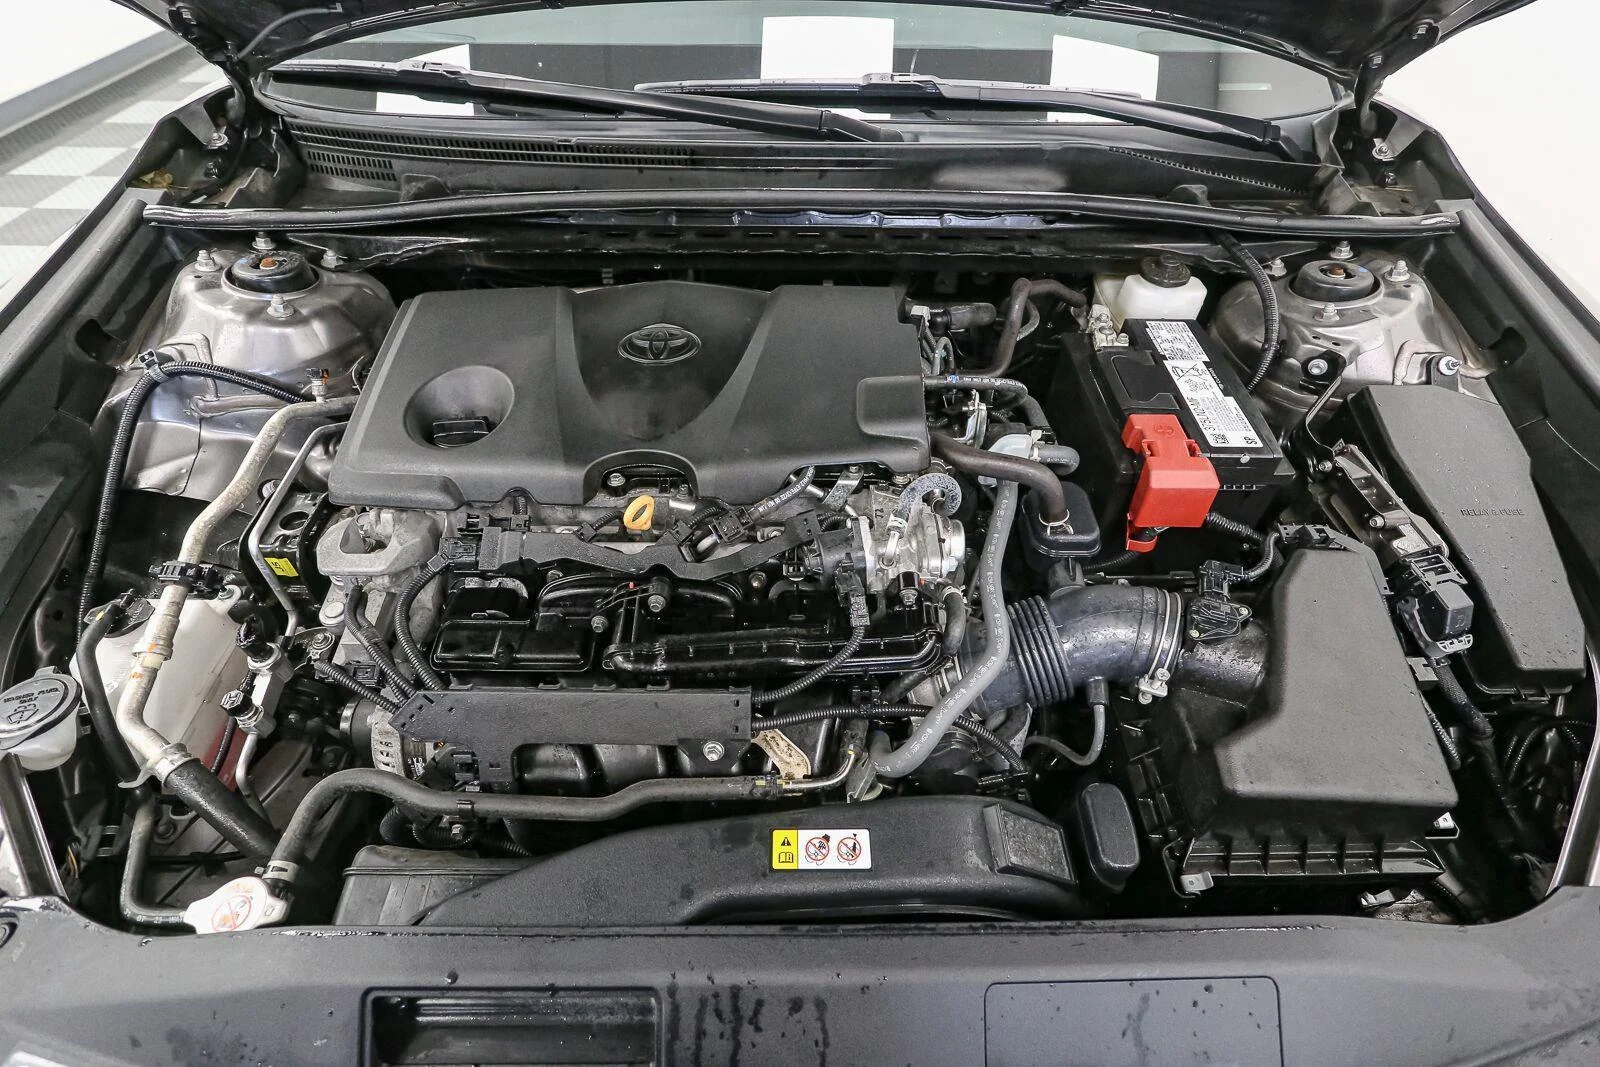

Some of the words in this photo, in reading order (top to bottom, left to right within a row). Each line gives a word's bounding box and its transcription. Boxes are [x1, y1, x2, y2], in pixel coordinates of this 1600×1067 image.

[1243, 436, 1258, 445] SP
[1460, 508, 1490, 516] RELAY
[1499, 508, 1525, 516] FUSE
